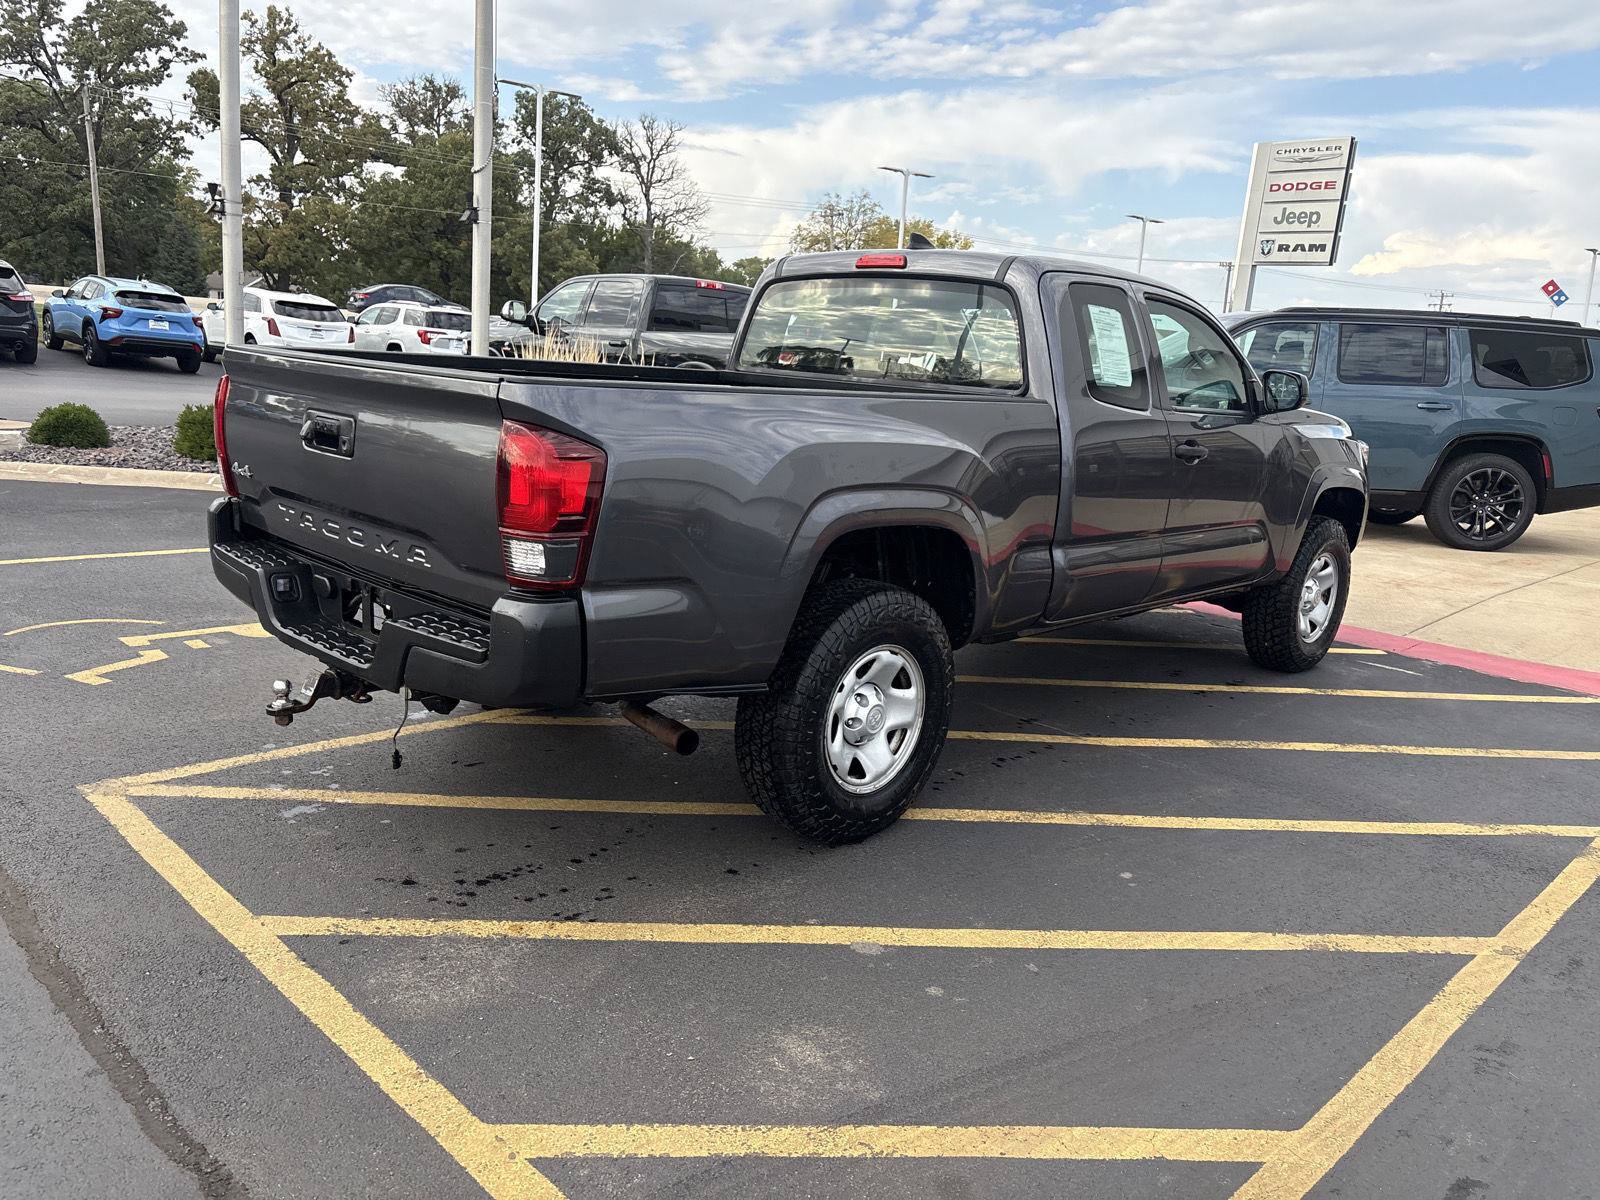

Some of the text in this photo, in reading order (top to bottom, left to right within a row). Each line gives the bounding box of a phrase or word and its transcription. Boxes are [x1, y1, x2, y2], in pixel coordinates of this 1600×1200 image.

[1276, 145, 1342, 155] CHRYSLER
[1269, 181, 1337, 192] DODGE
[1273, 207, 1321, 228] Jeep
[1277, 243, 1327, 252] RAM
[277, 503, 432, 568] TACOMA
